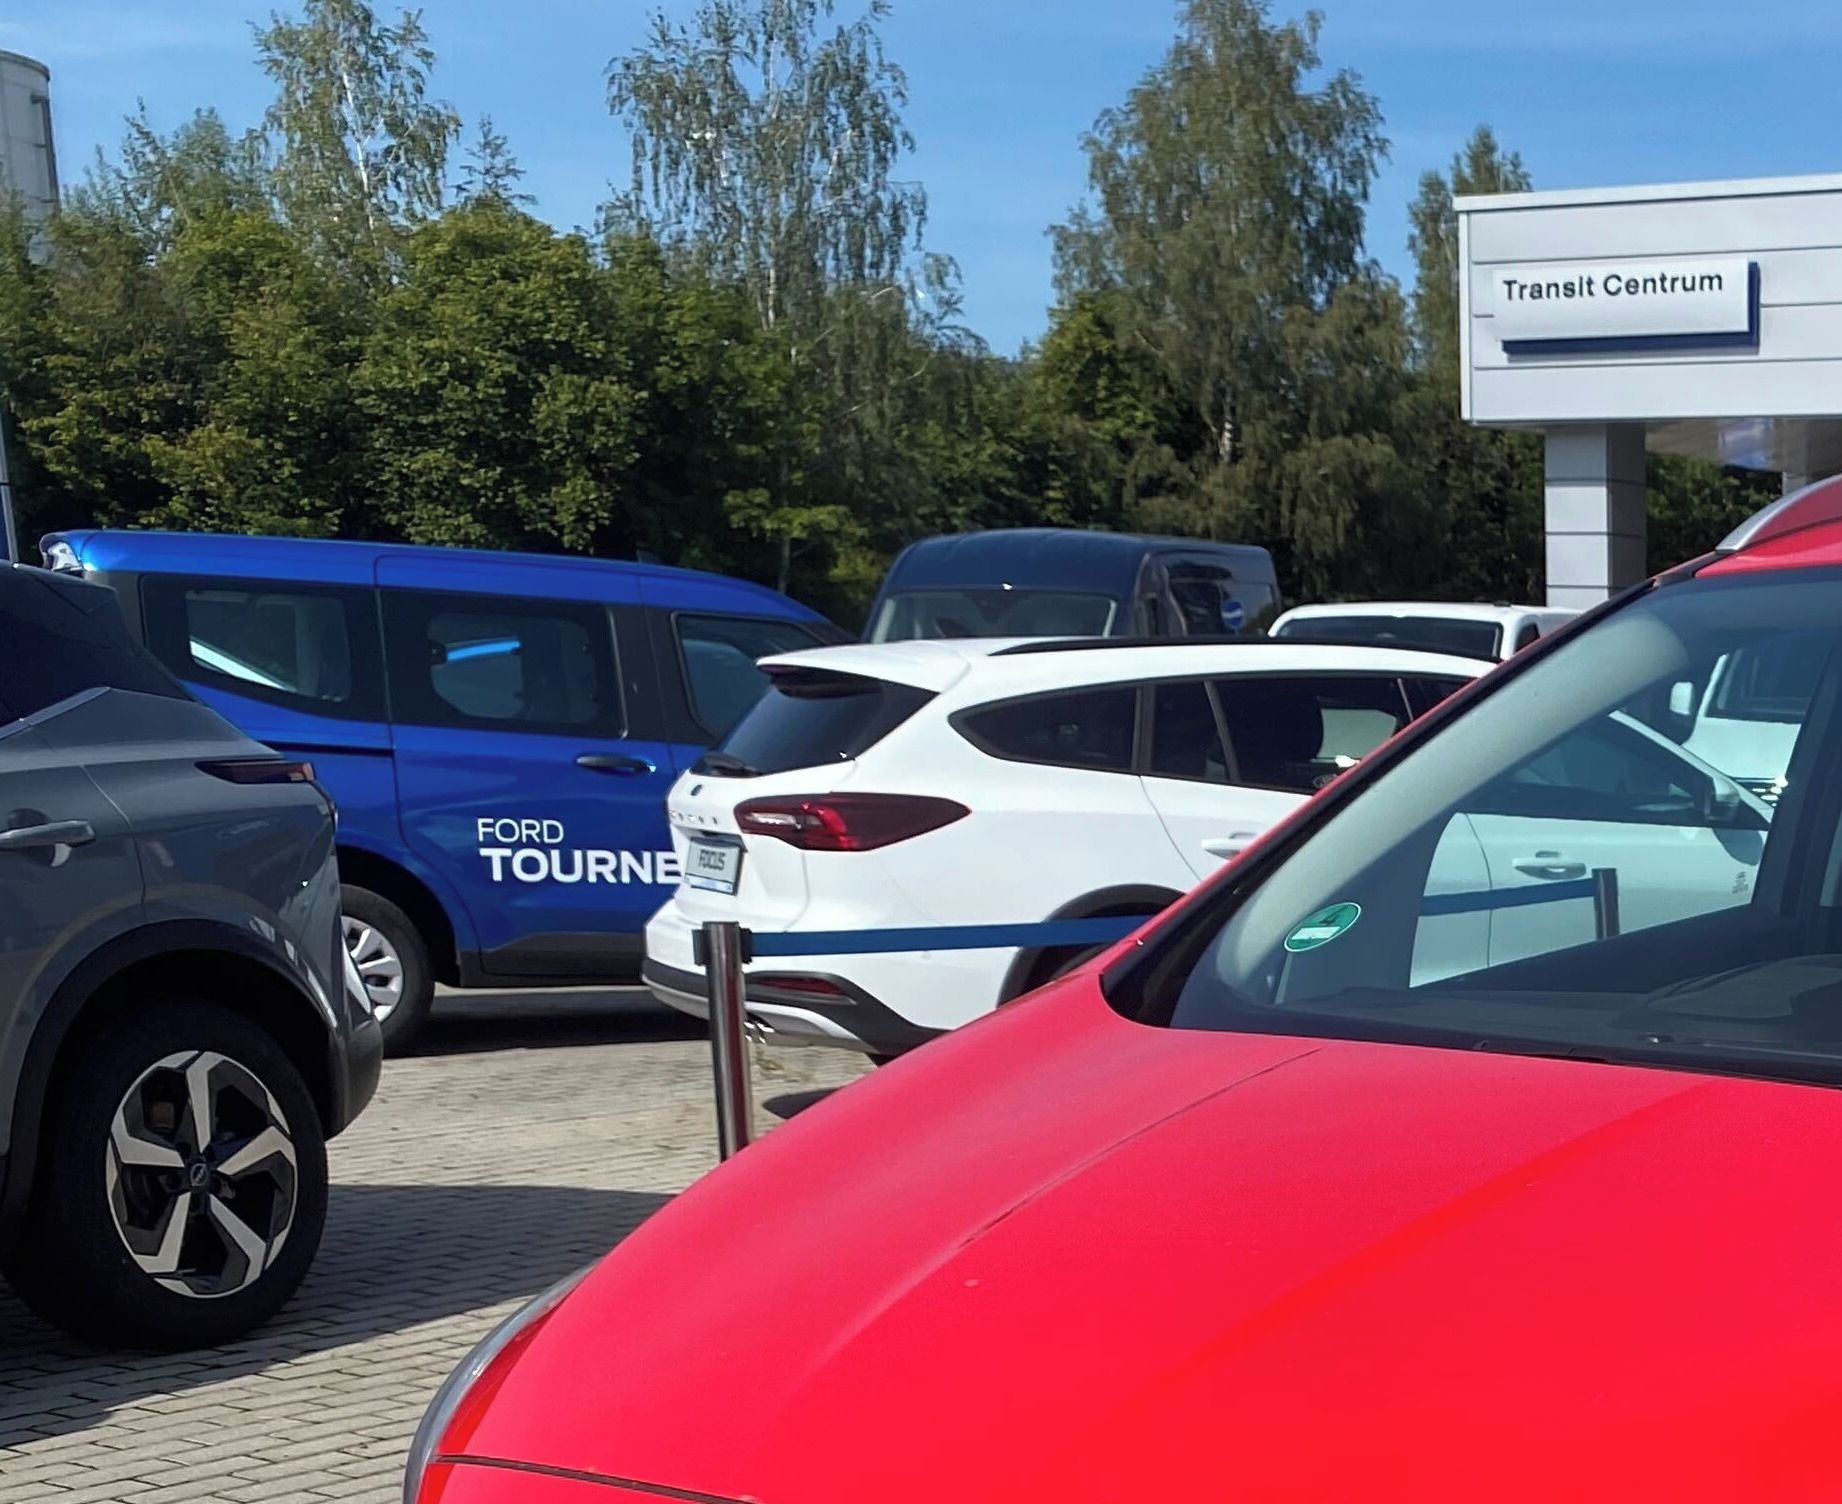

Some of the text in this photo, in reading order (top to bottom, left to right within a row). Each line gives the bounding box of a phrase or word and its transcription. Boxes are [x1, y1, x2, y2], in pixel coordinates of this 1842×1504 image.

[1502, 272, 1723, 301] Transit Centrum
[477, 817, 565, 844] FORD
[479, 847, 683, 885] TOURNE
